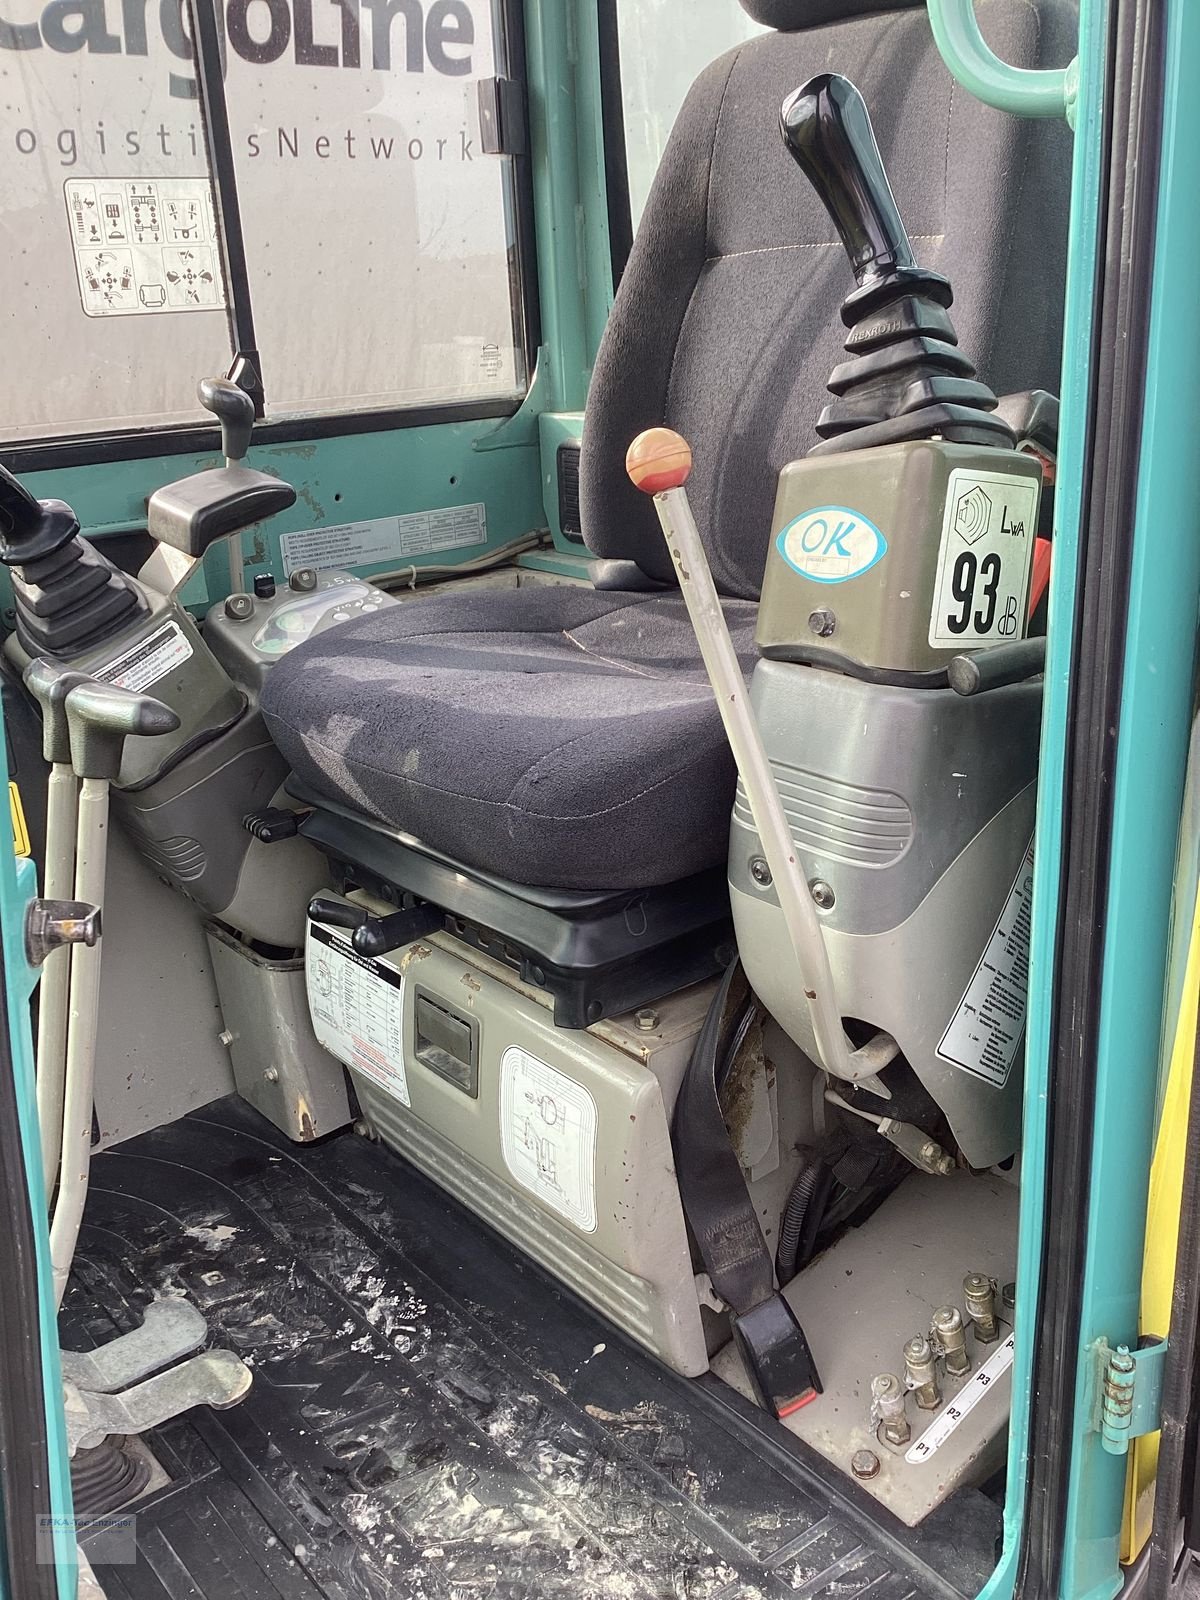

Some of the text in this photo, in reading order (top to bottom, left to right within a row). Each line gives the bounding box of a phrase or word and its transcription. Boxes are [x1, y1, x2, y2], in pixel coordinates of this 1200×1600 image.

[852, 319, 903, 342] REXROTH
[801, 518, 856, 556] OK
[947, 551, 1018, 635] 93 dB
[976, 1373, 991, 1386] P3
[946, 1407, 961, 1421] P2
[915, 1442, 930, 1456] P1
